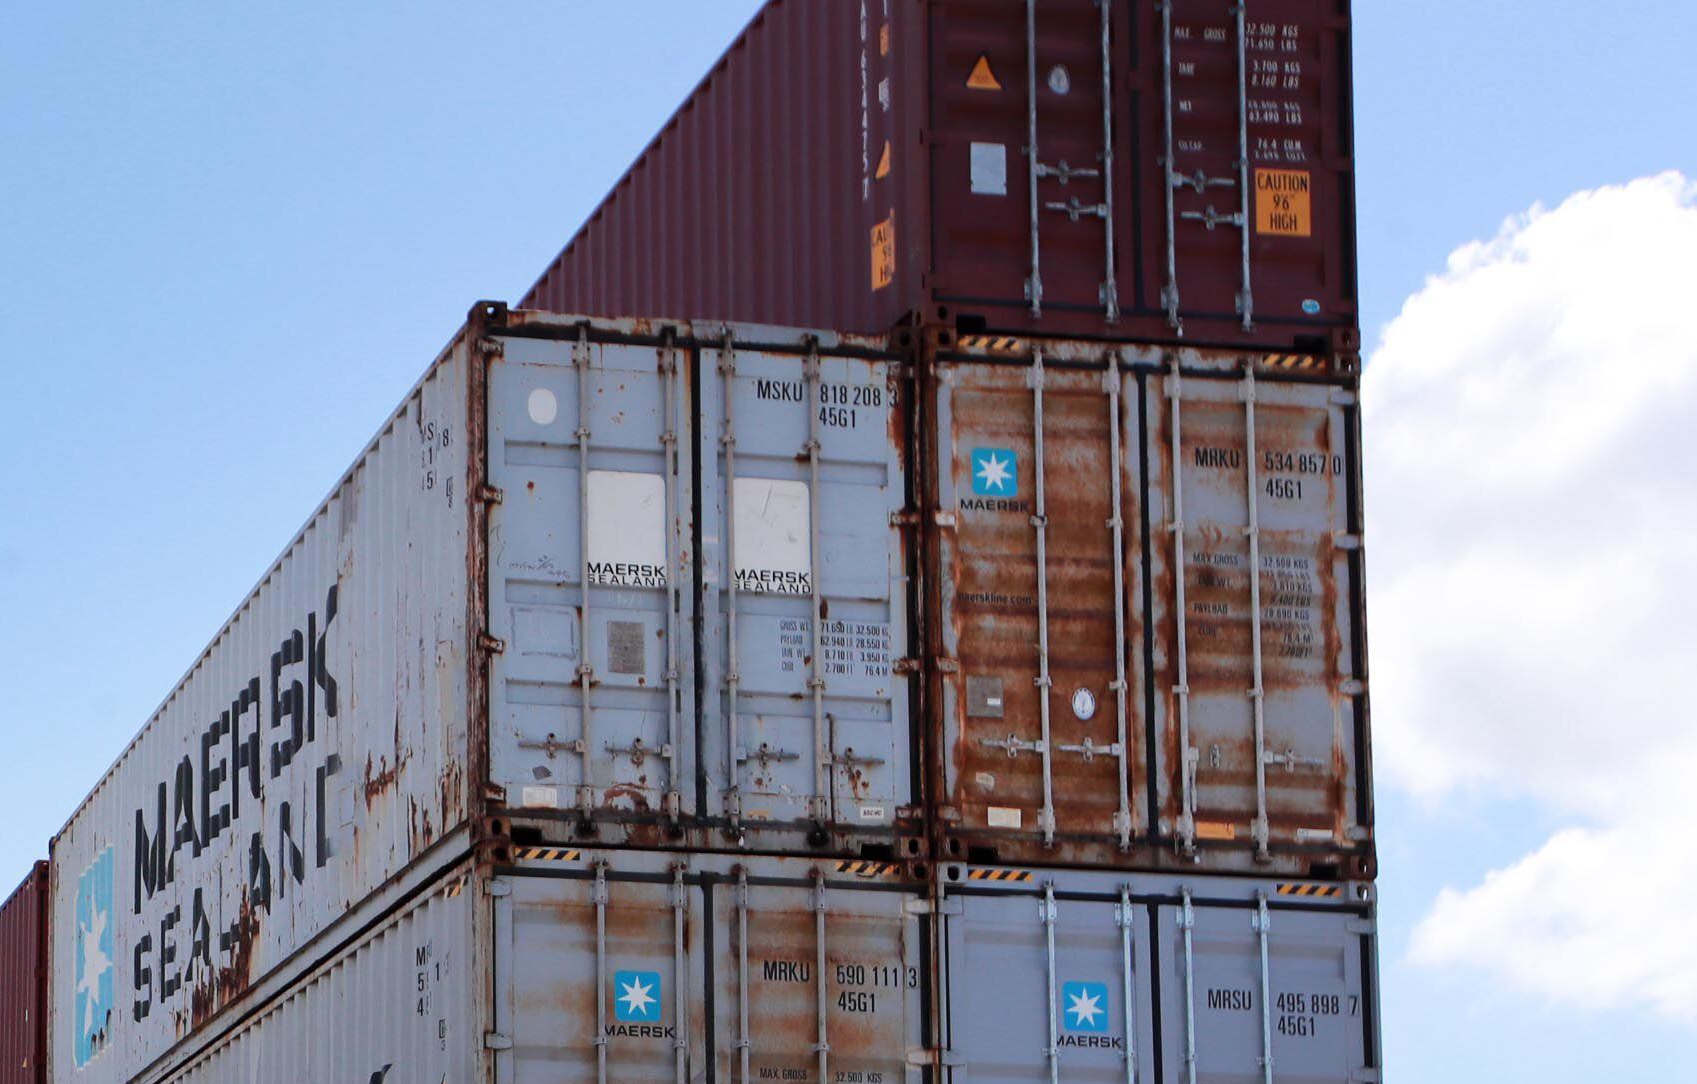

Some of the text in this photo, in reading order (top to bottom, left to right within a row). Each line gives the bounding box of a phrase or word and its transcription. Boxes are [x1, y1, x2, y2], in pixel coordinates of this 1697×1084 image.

[1282, 24, 1299, 38] KGS
[1282, 38, 1297, 51] LBS
[1284, 61, 1301, 74] KGS
[1283, 76, 1299, 89] LBS
[1286, 112, 1302, 124] LBS
[1257, 172, 1308, 193] CAUTION
[1270, 213, 1297, 231] HIGH
[757, 379, 803, 402] MSKU
[820, 384, 848, 405] 818
[853, 386, 882, 407] 208
[819, 407, 857, 428] 45G1
[1195, 447, 1240, 469] MRKU
[1265, 451, 1294, 473] 534
[1299, 453, 1327, 474] 857
[1266, 477, 1302, 500] 45G1
[960, 498, 1030, 513] MAERSK
[588, 561, 665, 578] MAERSK
[735, 568, 809, 585] MAERSK
[588, 574, 667, 587] SEALAND
[735, 580, 811, 595] SEALAND
[1194, 602, 1310, 620] PAYLOAD KGS
[134, 583, 339, 915] MAERSK
[763, 960, 810, 983] MRKU
[872, 966, 898, 988] 111
[908, 967, 917, 988] 3
[838, 991, 876, 1013] 45G1
[1208, 988, 1359, 1017] MRSU 495 898 7
[605, 1024, 676, 1039] MAERSK
[1278, 1015, 1316, 1037] 45G1
[1056, 1035, 1122, 1049] MAERSK
[783, 1069, 883, 1084] GROSS KGS
